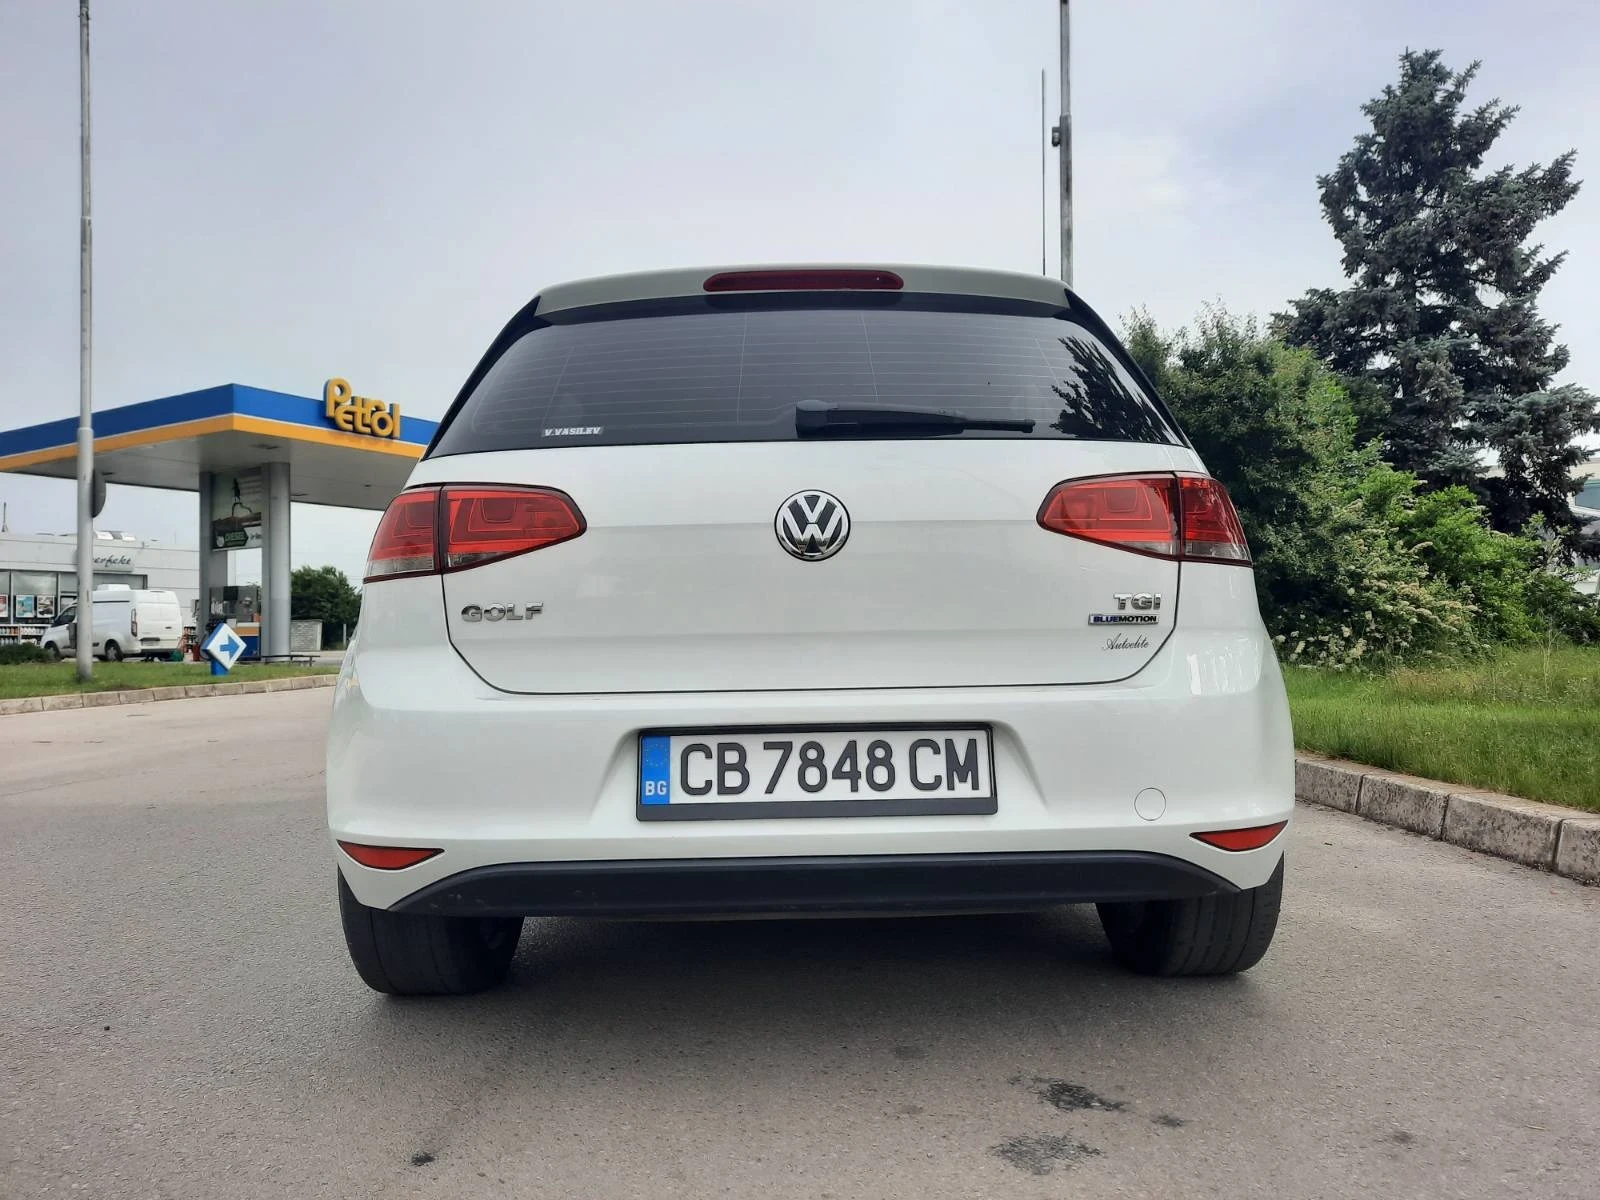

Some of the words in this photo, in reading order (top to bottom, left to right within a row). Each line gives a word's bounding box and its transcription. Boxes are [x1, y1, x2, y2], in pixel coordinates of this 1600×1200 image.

[323, 377, 400, 440] Petrol
[544, 427, 601, 437] V.VASILEV
[92, 554, 131, 567] erfekt
[1112, 592, 1161, 610] TGI
[461, 602, 544, 622] GOLF
[680, 742, 750, 796] CB
[763, 739, 896, 794] 7848
[909, 738, 979, 791] CM
[645, 780, 668, 796] BG
